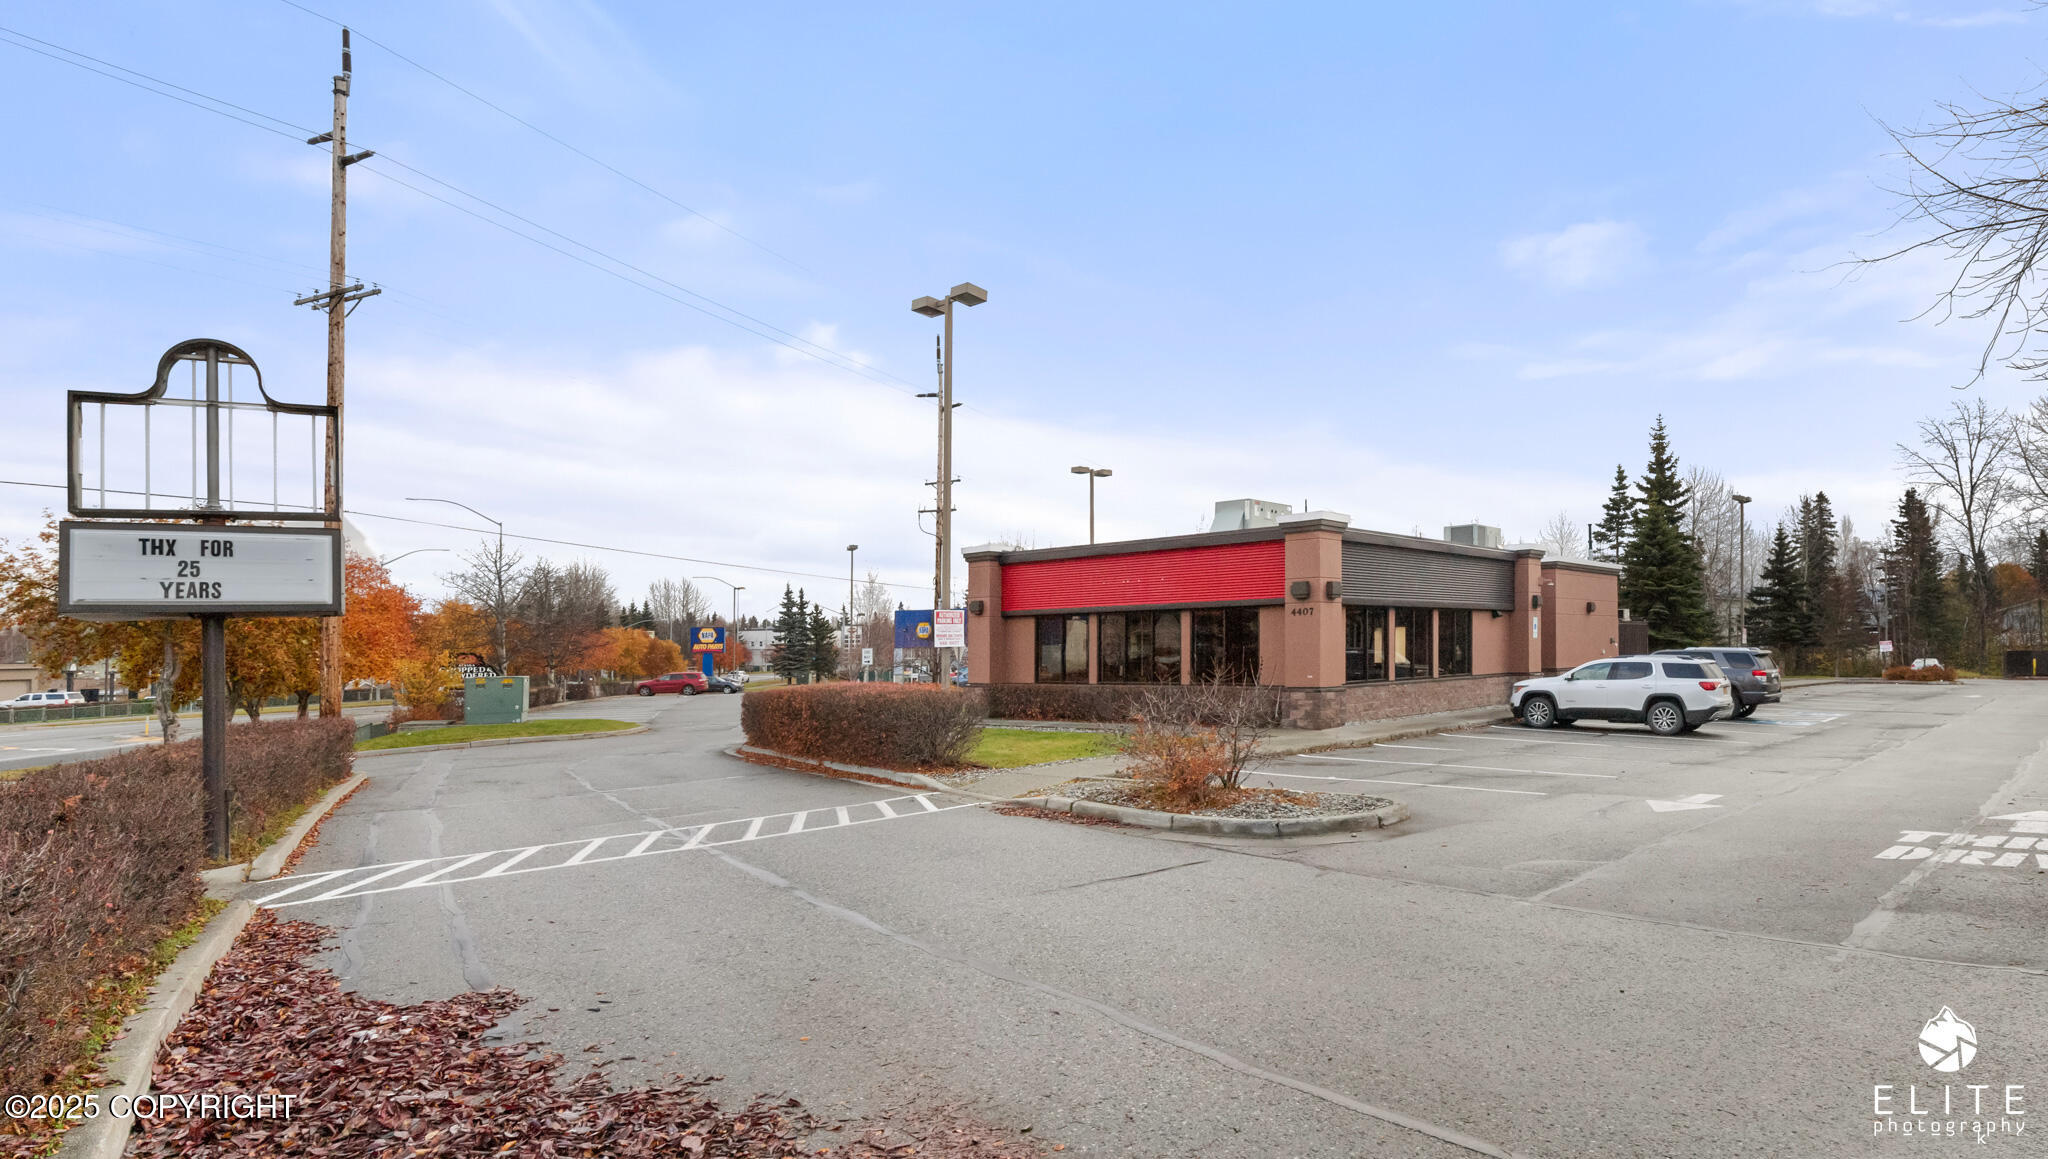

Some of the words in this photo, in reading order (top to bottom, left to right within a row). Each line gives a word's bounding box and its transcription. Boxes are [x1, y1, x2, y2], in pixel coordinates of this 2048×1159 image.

[138, 538, 177, 556] THX
[200, 539, 234, 557] FOR
[177, 560, 201, 577] 25
[160, 581, 222, 599] YEARS
[1291, 607, 1314, 616] 4407
